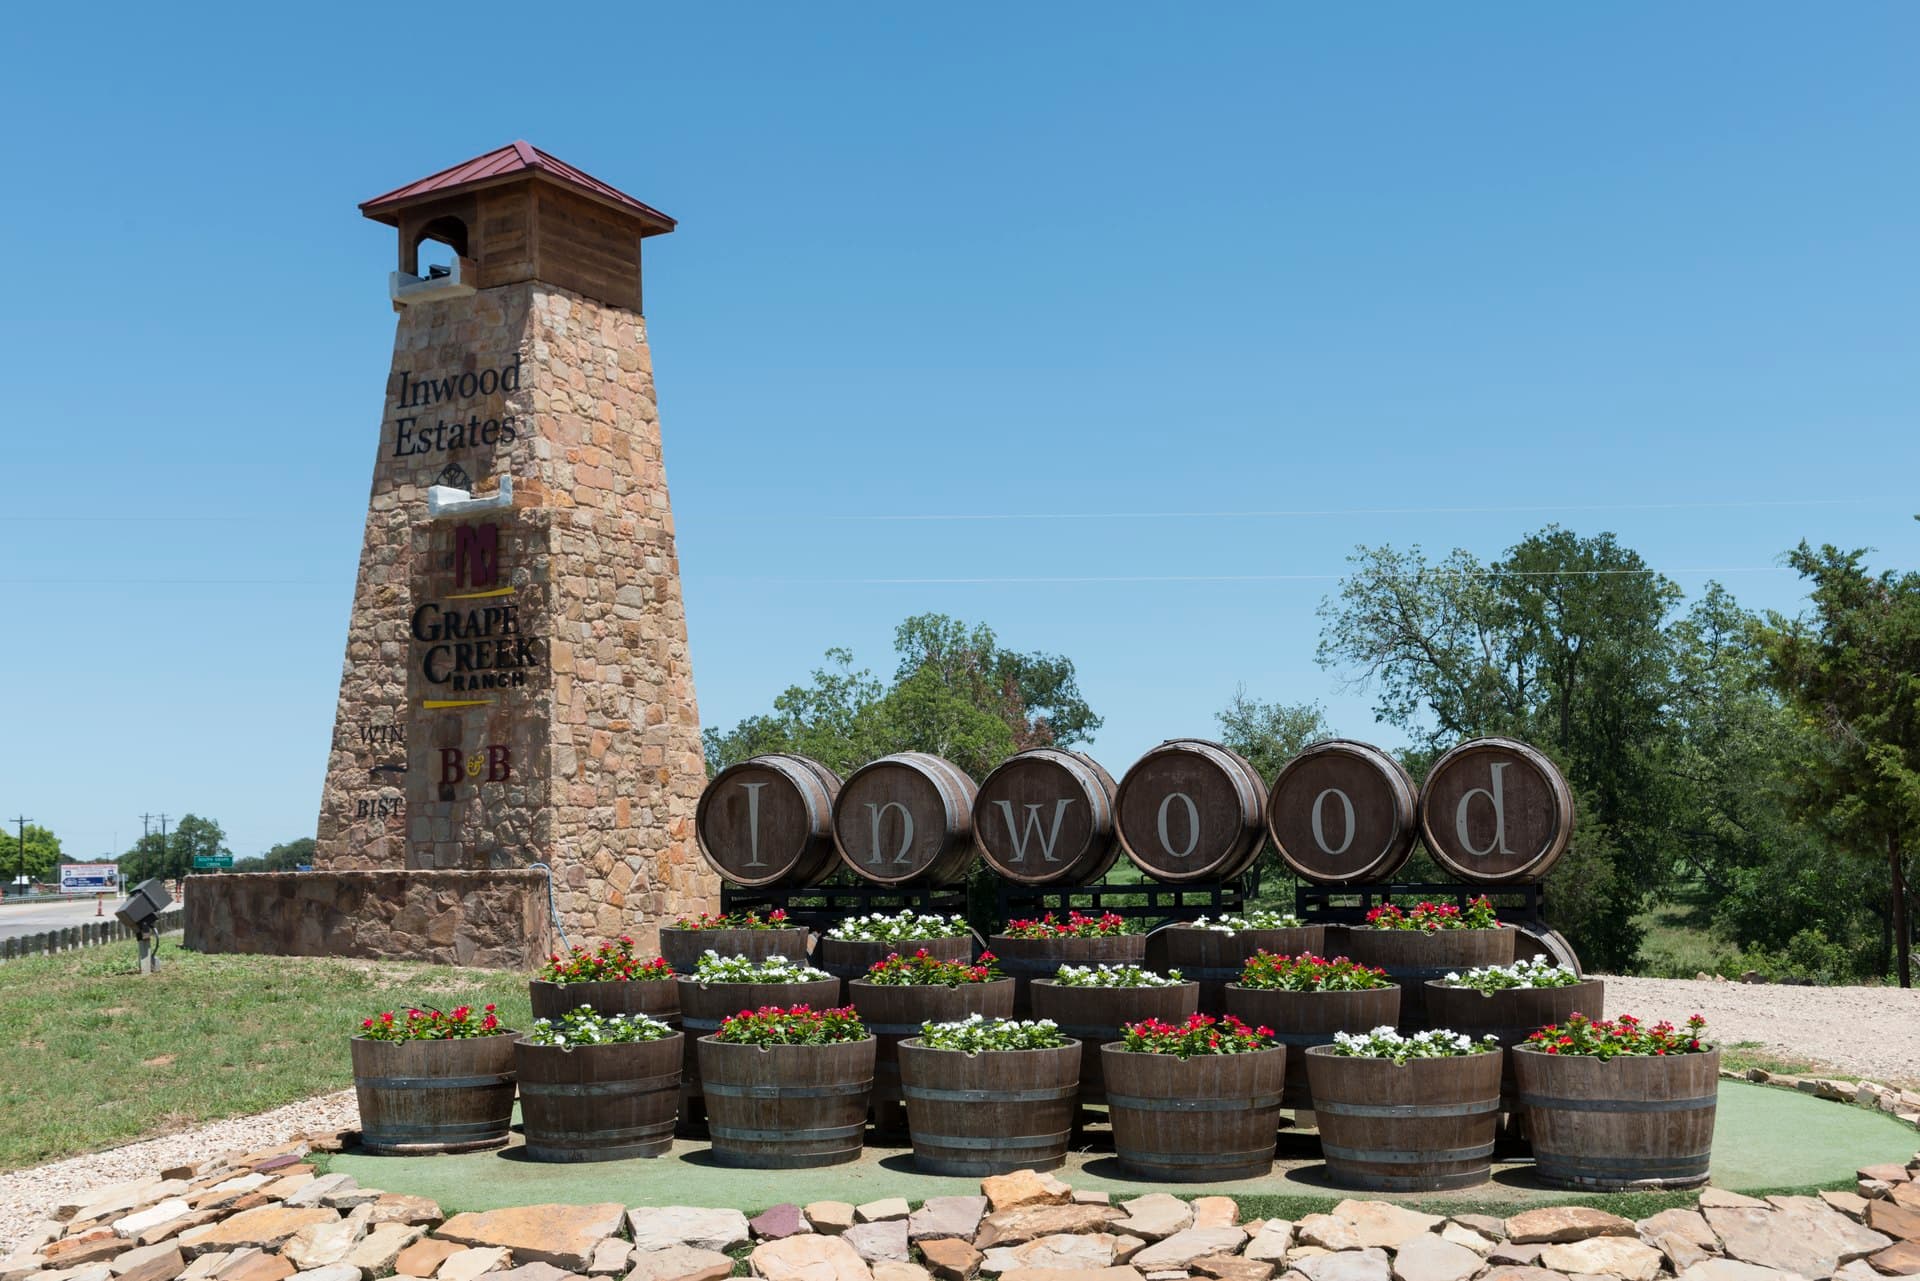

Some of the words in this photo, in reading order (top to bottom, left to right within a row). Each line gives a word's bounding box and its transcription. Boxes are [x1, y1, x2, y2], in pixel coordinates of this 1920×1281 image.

[397, 353, 521, 409] Inwood
[392, 416, 516, 457] Estates
[412, 604, 520, 642] GRAPE
[424, 637, 539, 683] CREEK
[453, 672, 524, 691] RANCH
